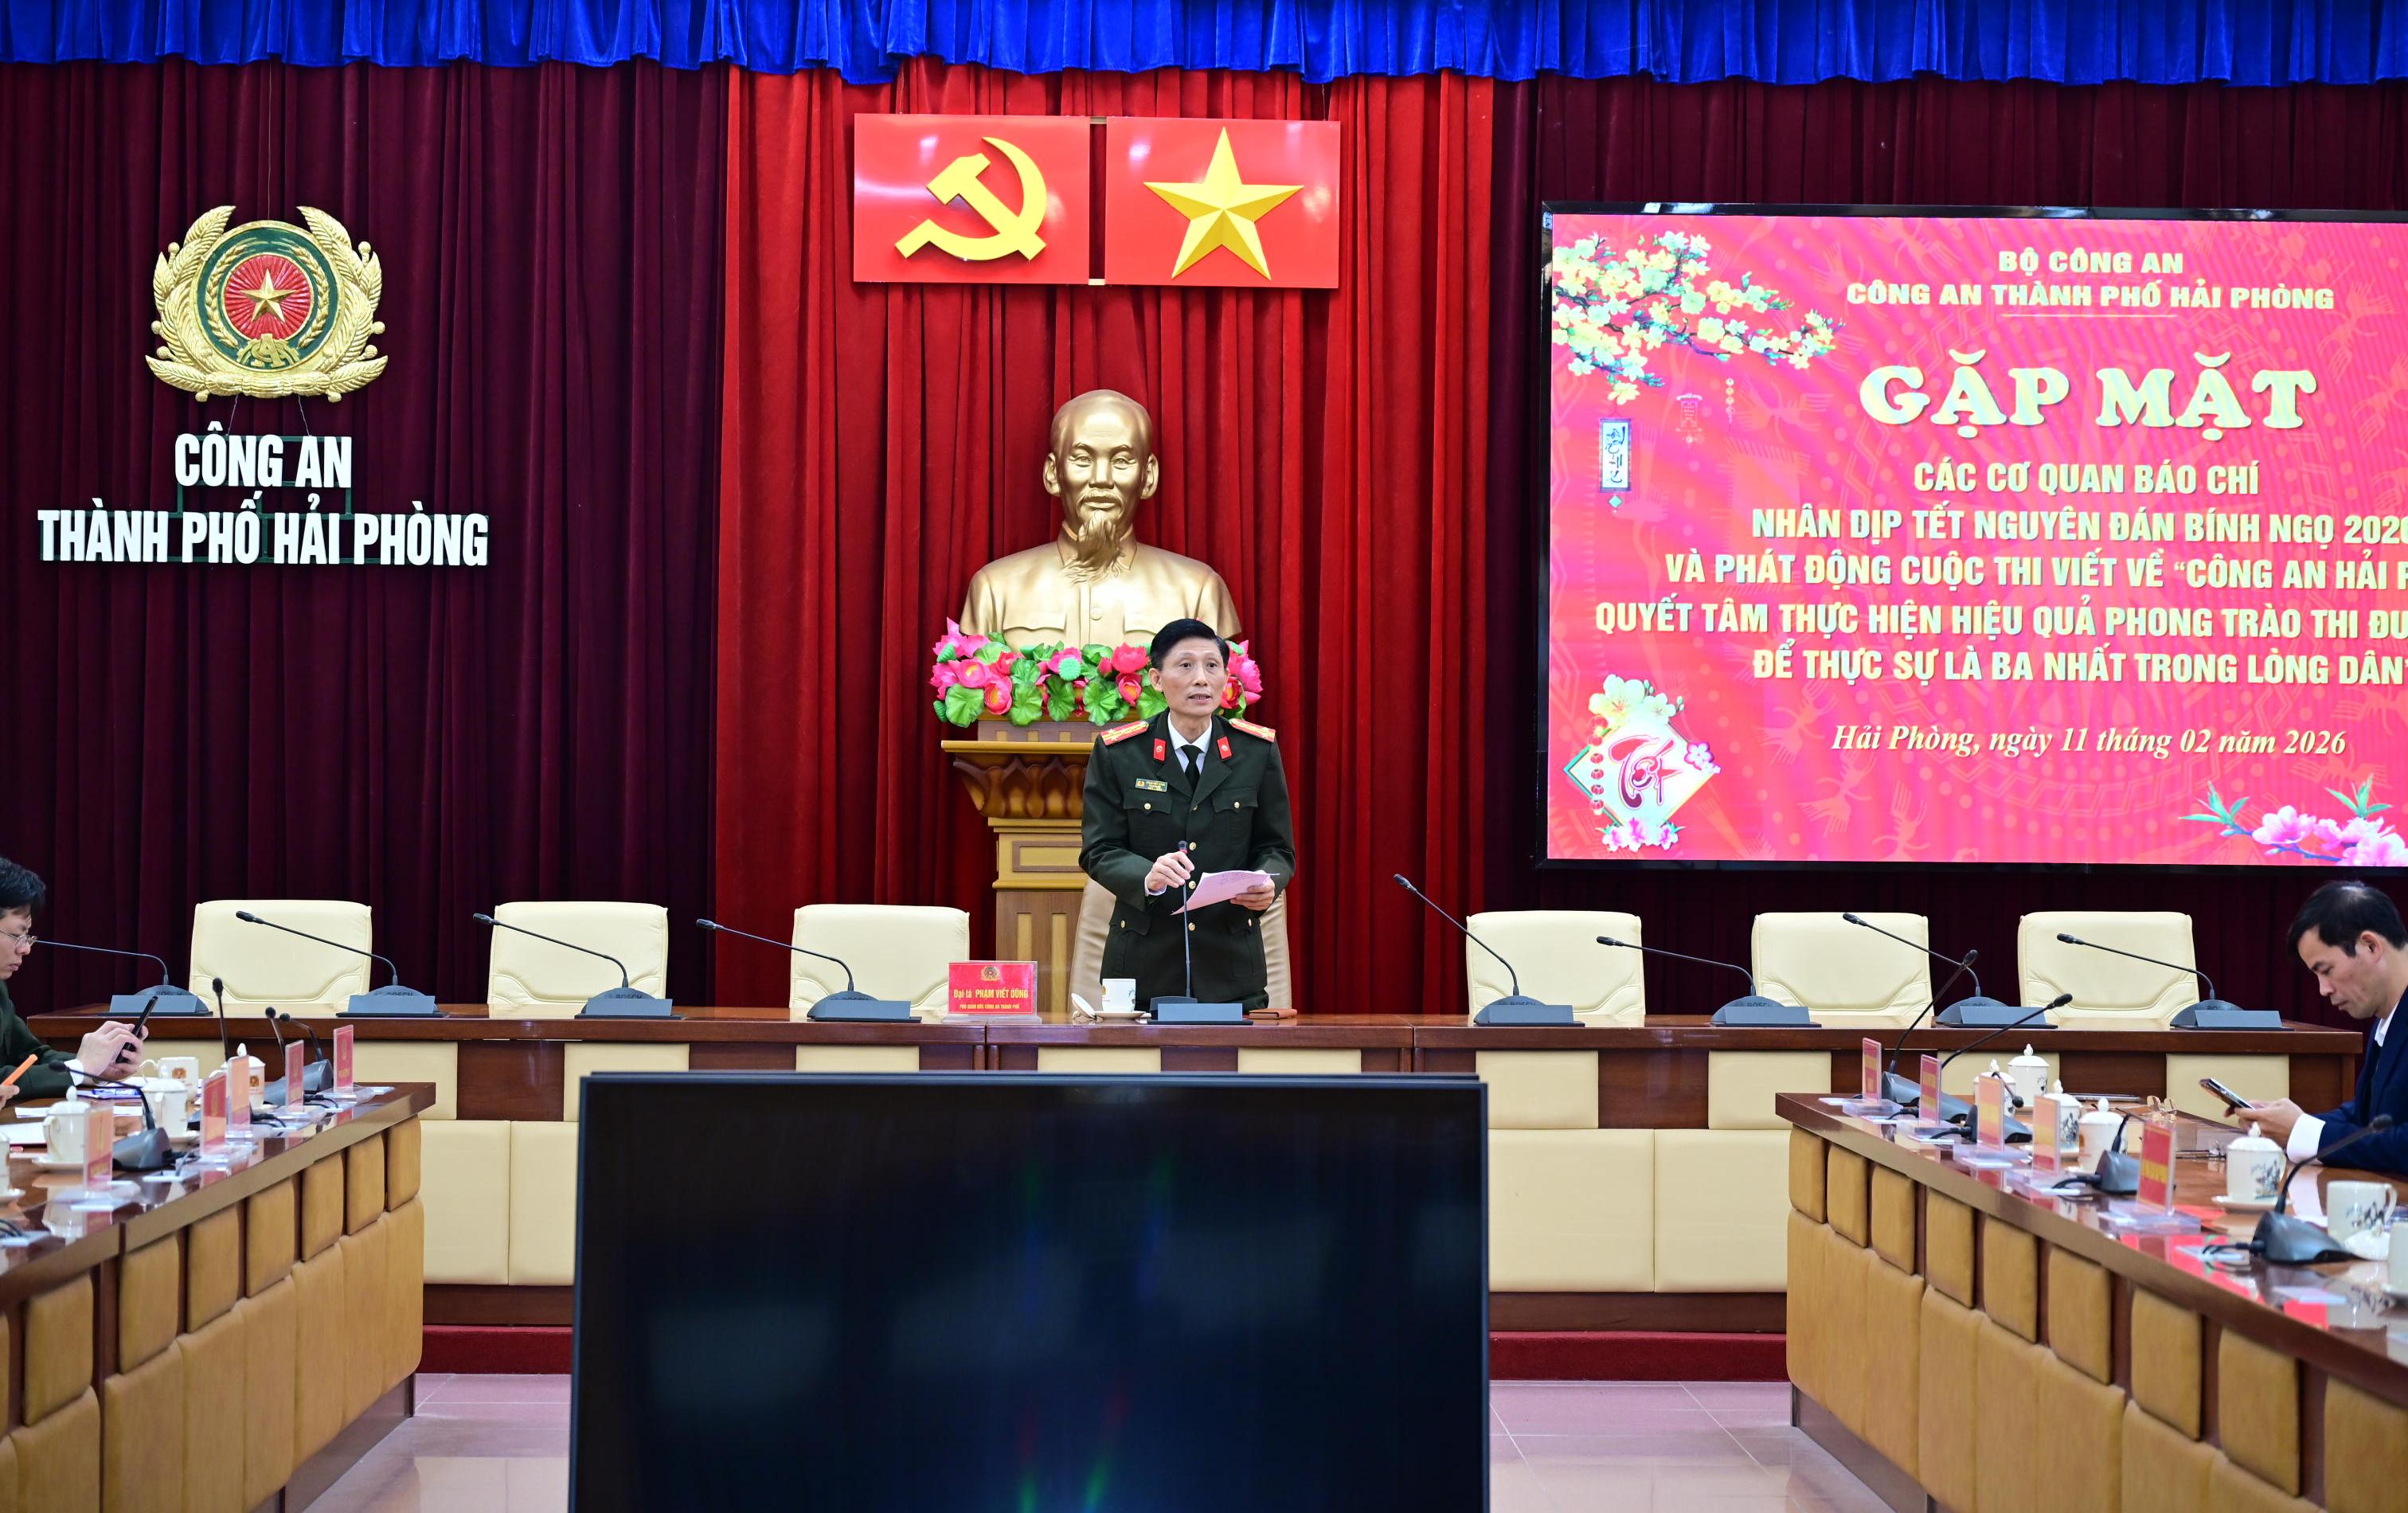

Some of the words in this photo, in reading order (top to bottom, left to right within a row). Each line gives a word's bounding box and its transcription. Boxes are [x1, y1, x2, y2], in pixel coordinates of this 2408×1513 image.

[1999, 246, 2039, 277] BỘ
[2049, 247, 2132, 274] CÔNG
[2140, 252, 2183, 274] AN
[1847, 279, 1930, 305] CÔNG
[1939, 283, 1982, 306] AN
[1991, 280, 2092, 307] THÀNH
[2100, 279, 2163, 308] PHỐ
[2170, 278, 2222, 308] HẢI
[2230, 283, 2334, 310] PHÒNG
[1859, 348, 2070, 438] GẶP
[2095, 351, 2317, 441] MẶT
[174, 420, 283, 487] CÔNG
[295, 436, 352, 488] AN
[1914, 455, 1976, 492] CÁC
[1987, 461, 2031, 493] CƠ
[2038, 463, 2124, 496] QUAN
[2134, 459, 2197, 495] BÁO
[2207, 459, 2259, 495] CHÍ
[37, 498, 169, 562] THÀNH
[182, 491, 264, 564] PHỐ
[274, 493, 340, 565] HẢI
[353, 500, 489, 566] PHÒNG
[1752, 502, 1841, 538] NHÂN
[1850, 509, 1902, 545] DỊP
[1911, 500, 1965, 539] TẾT
[1974, 505, 2101, 541] NGUYÊN
[2108, 506, 2175, 541] ĐÁN
[2184, 506, 2260, 542] BÍNH
[2269, 514, 2334, 549] NGỌ
[1665, 548, 1706, 583] VÀ
[1715, 548, 1796, 584] PHÁT
[1804, 549, 1891, 590] ĐỘNG
[1901, 550, 1984, 592] CUỘC
[1993, 556, 2042, 586] THI
[2050, 547, 2117, 587] VIẾT
[2126, 548, 2164, 587] VỀ
[2174, 553, 2273, 588] “CÔNG
[2282, 560, 2326, 589] AN
[2336, 549, 2387, 590] HẢI
[1595, 592, 1693, 635] QUYẾT
[1701, 597, 1768, 632] TÂM
[1778, 601, 1859, 641] THỰC
[1868, 599, 1941, 640] HIỆN
[1951, 599, 2023, 641] HIỆU
[2033, 594, 2096, 639] QUẢ
[2105, 606, 2213, 637] PHONG
[2220, 603, 2301, 638] TRÀO
[2310, 609, 2358, 639] THI
[1752, 638, 1796, 678] ĐỂ
[1802, 647, 1882, 686] THỰC
[1893, 648, 1939, 686] SỰ
[1945, 645, 1982, 680] LÀ
[1992, 651, 2034, 681] BA
[2043, 642, 2127, 682] NHẤT
[2133, 652, 2238, 683] TRONG
[2247, 647, 2329, 684] LÒNG
[1831, 725, 1882, 749] Hải
[1888, 725, 1980, 757] Phòng,
[1989, 725, 2053, 758] ngày
[2061, 727, 2088, 751] 11
[2097, 727, 2172, 760] tháng
[2180, 729, 2211, 753] 02
[2218, 730, 2276, 753] năm
[2283, 729, 2346, 754] 2026
[975, 989, 995, 1001] PHẠM
[995, 987, 1010, 999] VIẾT
